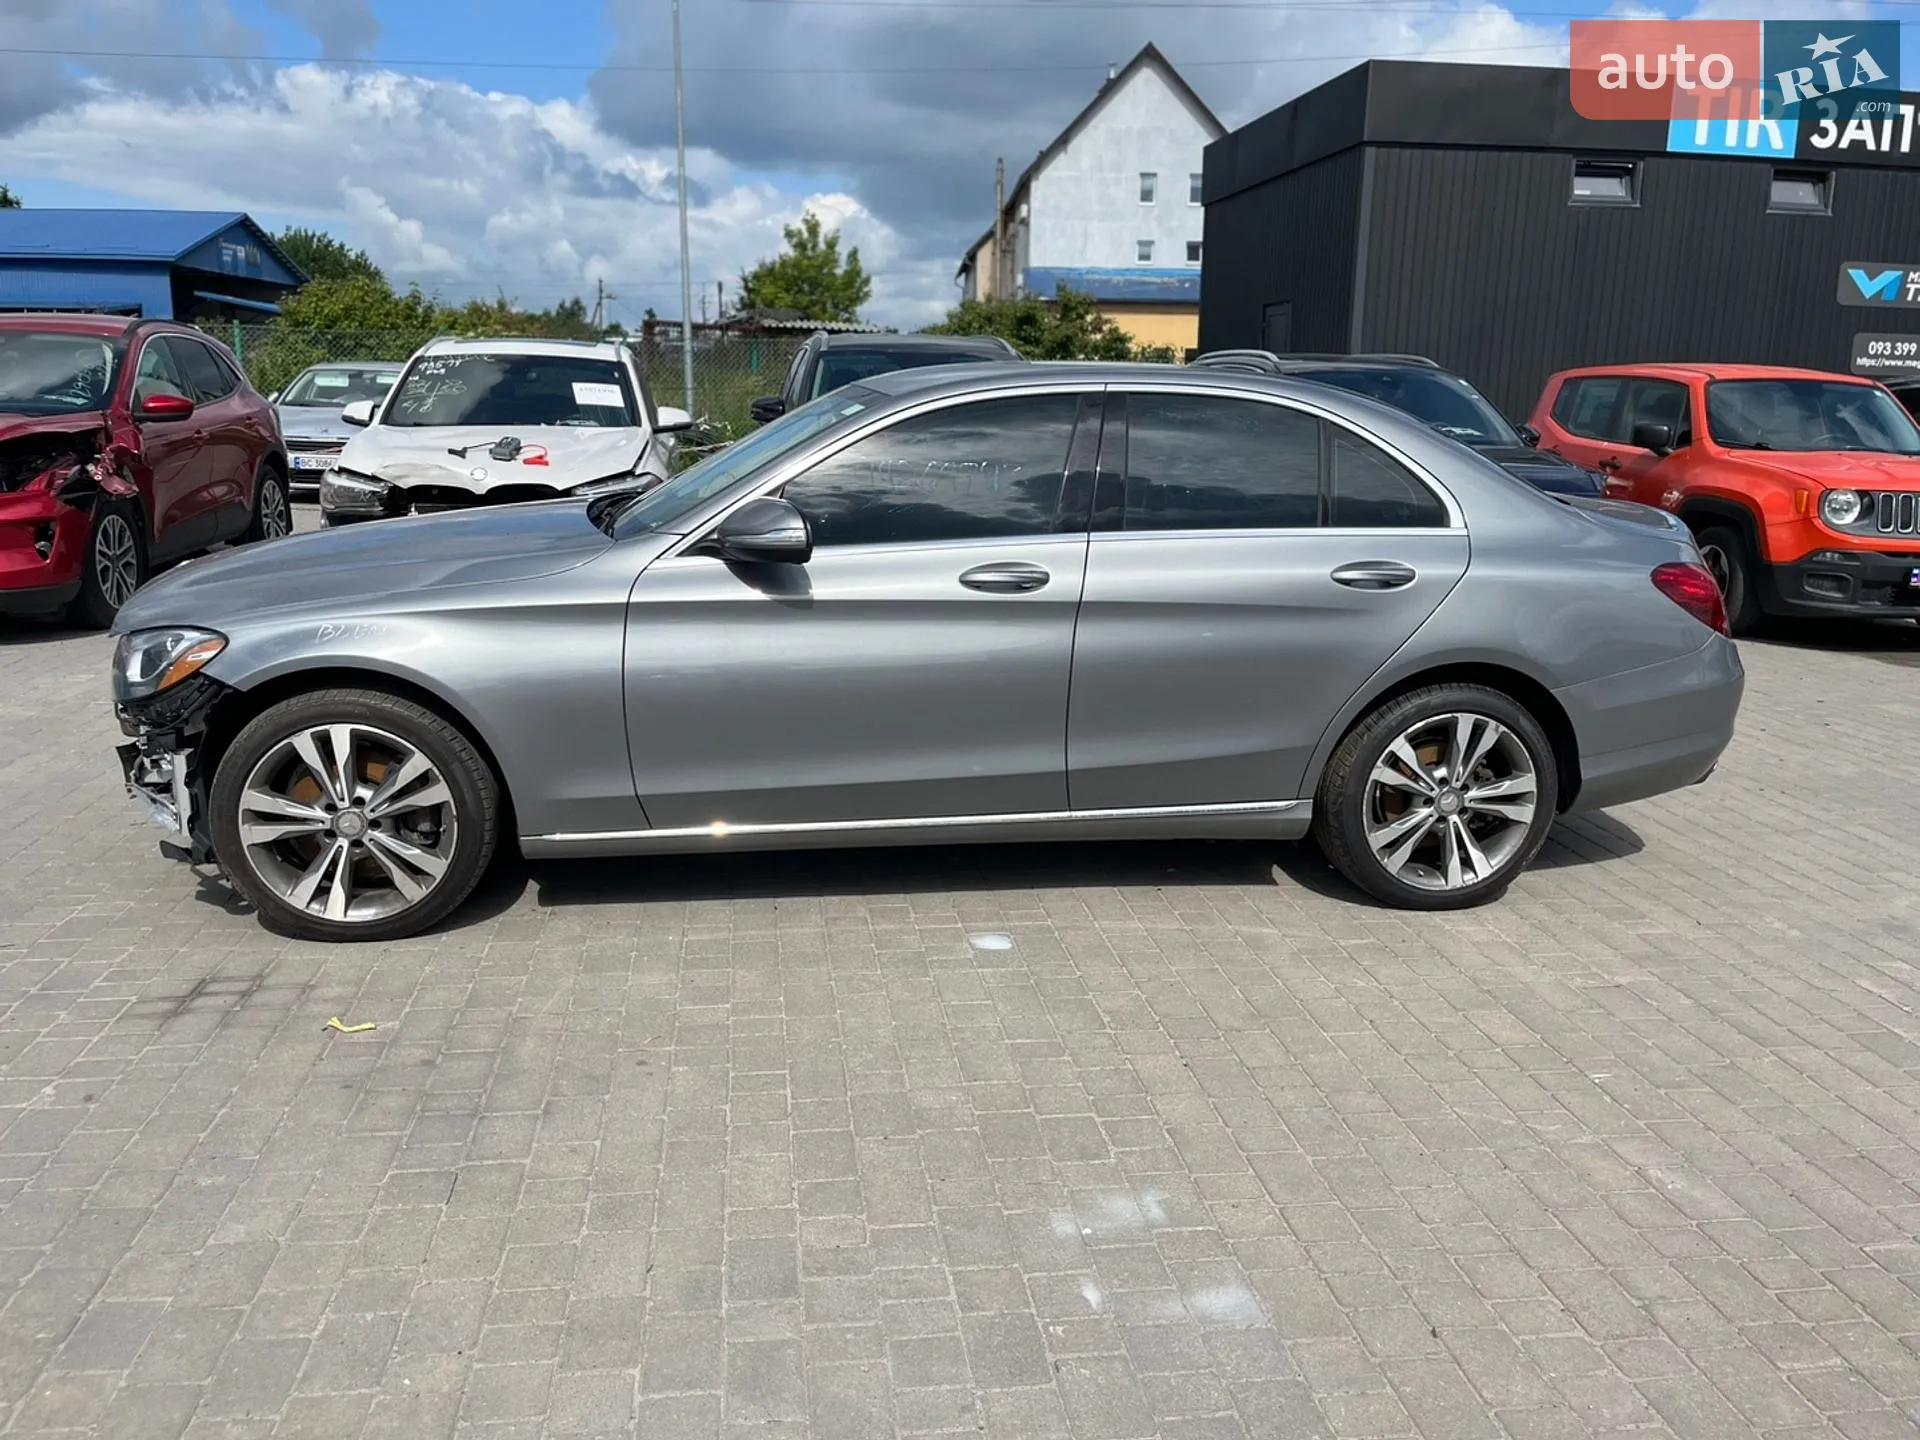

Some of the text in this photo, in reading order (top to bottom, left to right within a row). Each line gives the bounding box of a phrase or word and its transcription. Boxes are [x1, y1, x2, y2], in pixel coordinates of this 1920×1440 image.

[1686, 85, 1920, 153] TIR ЗАП
[1868, 341, 1918, 356] 093 399
